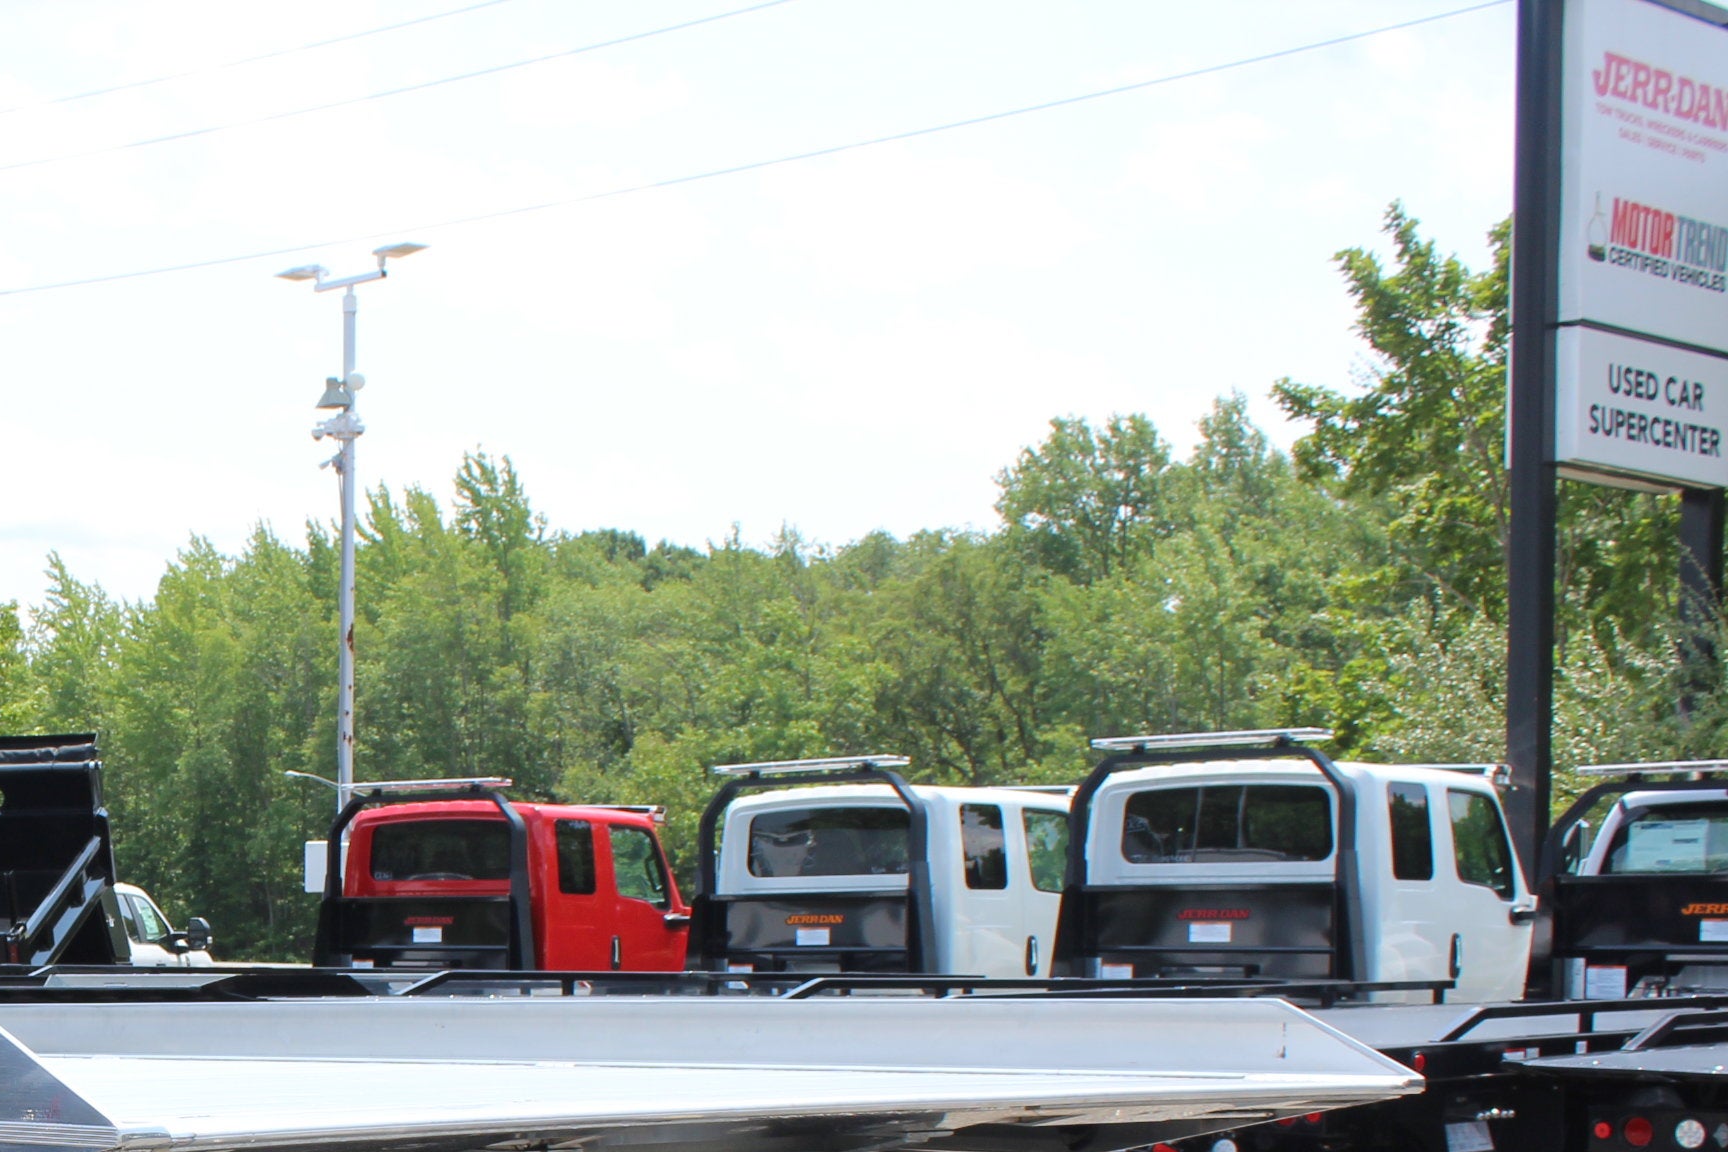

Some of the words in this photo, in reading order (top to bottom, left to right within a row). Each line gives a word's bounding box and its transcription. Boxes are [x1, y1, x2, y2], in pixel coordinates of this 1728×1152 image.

[1609, 246, 1669, 278] CERTIFIED
[1672, 262, 1726, 292] VEHICLES
[1609, 363, 1658, 400] USED
[1665, 376, 1703, 411] CAR
[1590, 404, 1720, 458] SUPERCENTER
